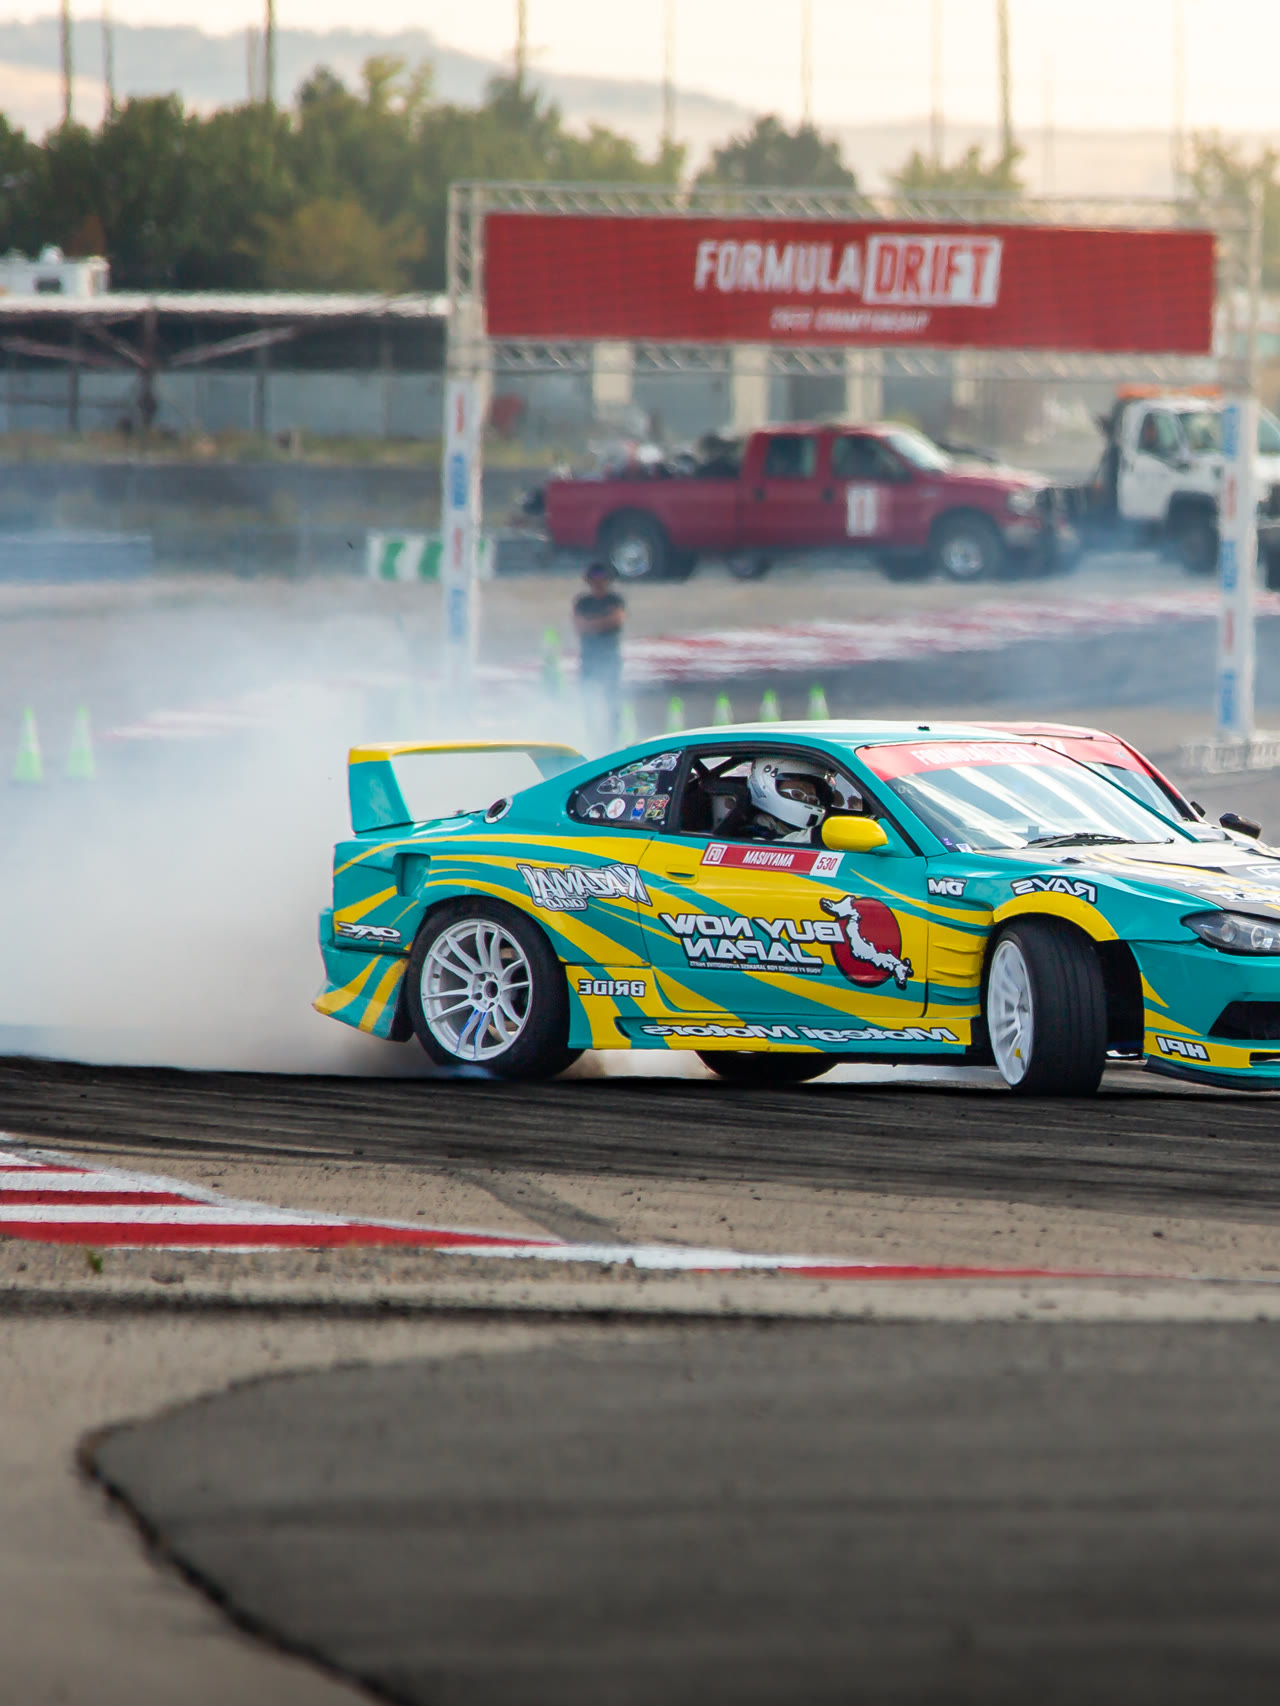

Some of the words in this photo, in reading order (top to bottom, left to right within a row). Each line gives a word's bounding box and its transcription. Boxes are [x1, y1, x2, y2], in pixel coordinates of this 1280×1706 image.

[694, 240, 864, 294] FORMULA
[870, 242, 993, 297] DRIFT
[742, 851, 795, 868] MASUYAMA
[816, 856, 839, 871] 530
